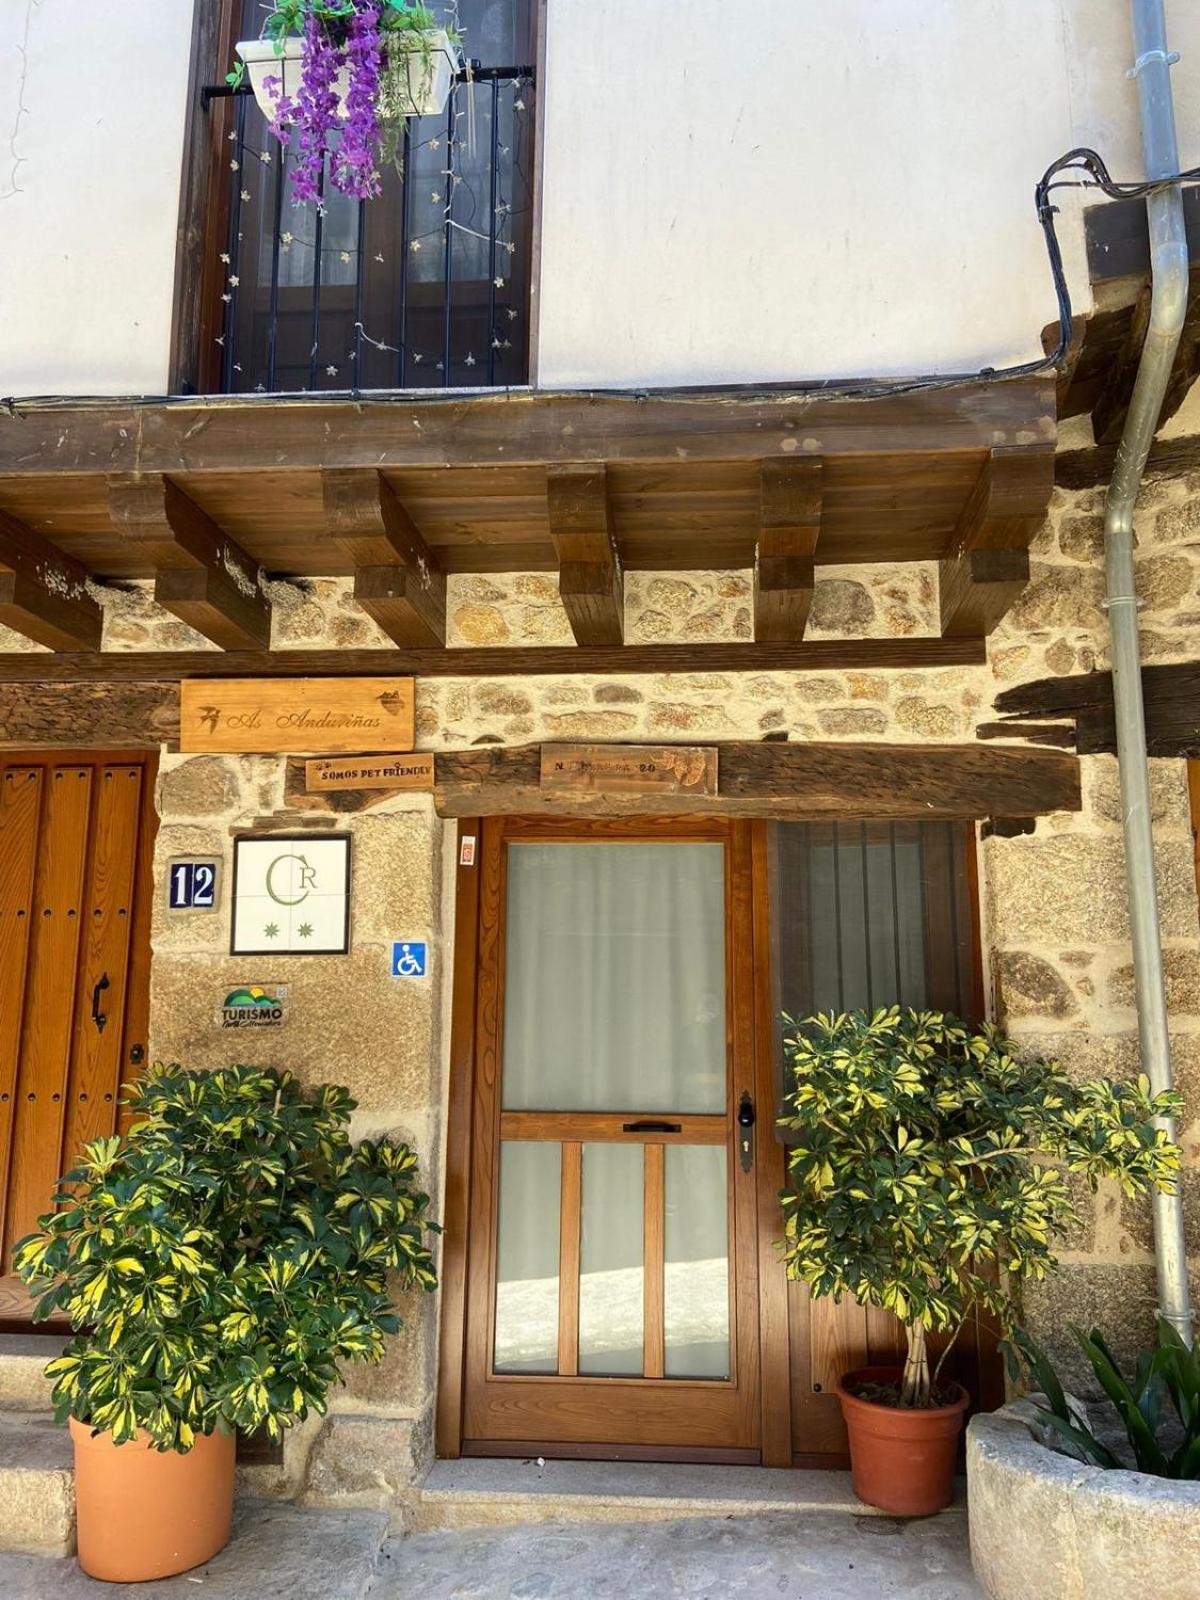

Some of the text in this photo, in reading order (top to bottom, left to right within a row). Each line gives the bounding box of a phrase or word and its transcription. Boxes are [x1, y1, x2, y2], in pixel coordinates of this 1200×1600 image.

[226, 707, 381, 730] As Anduriñas
[321, 769, 359, 781] SOMOS
[360, 768, 382, 779] PET
[174, 866, 213, 906] 12
[221, 1008, 283, 1021] TURISMO
